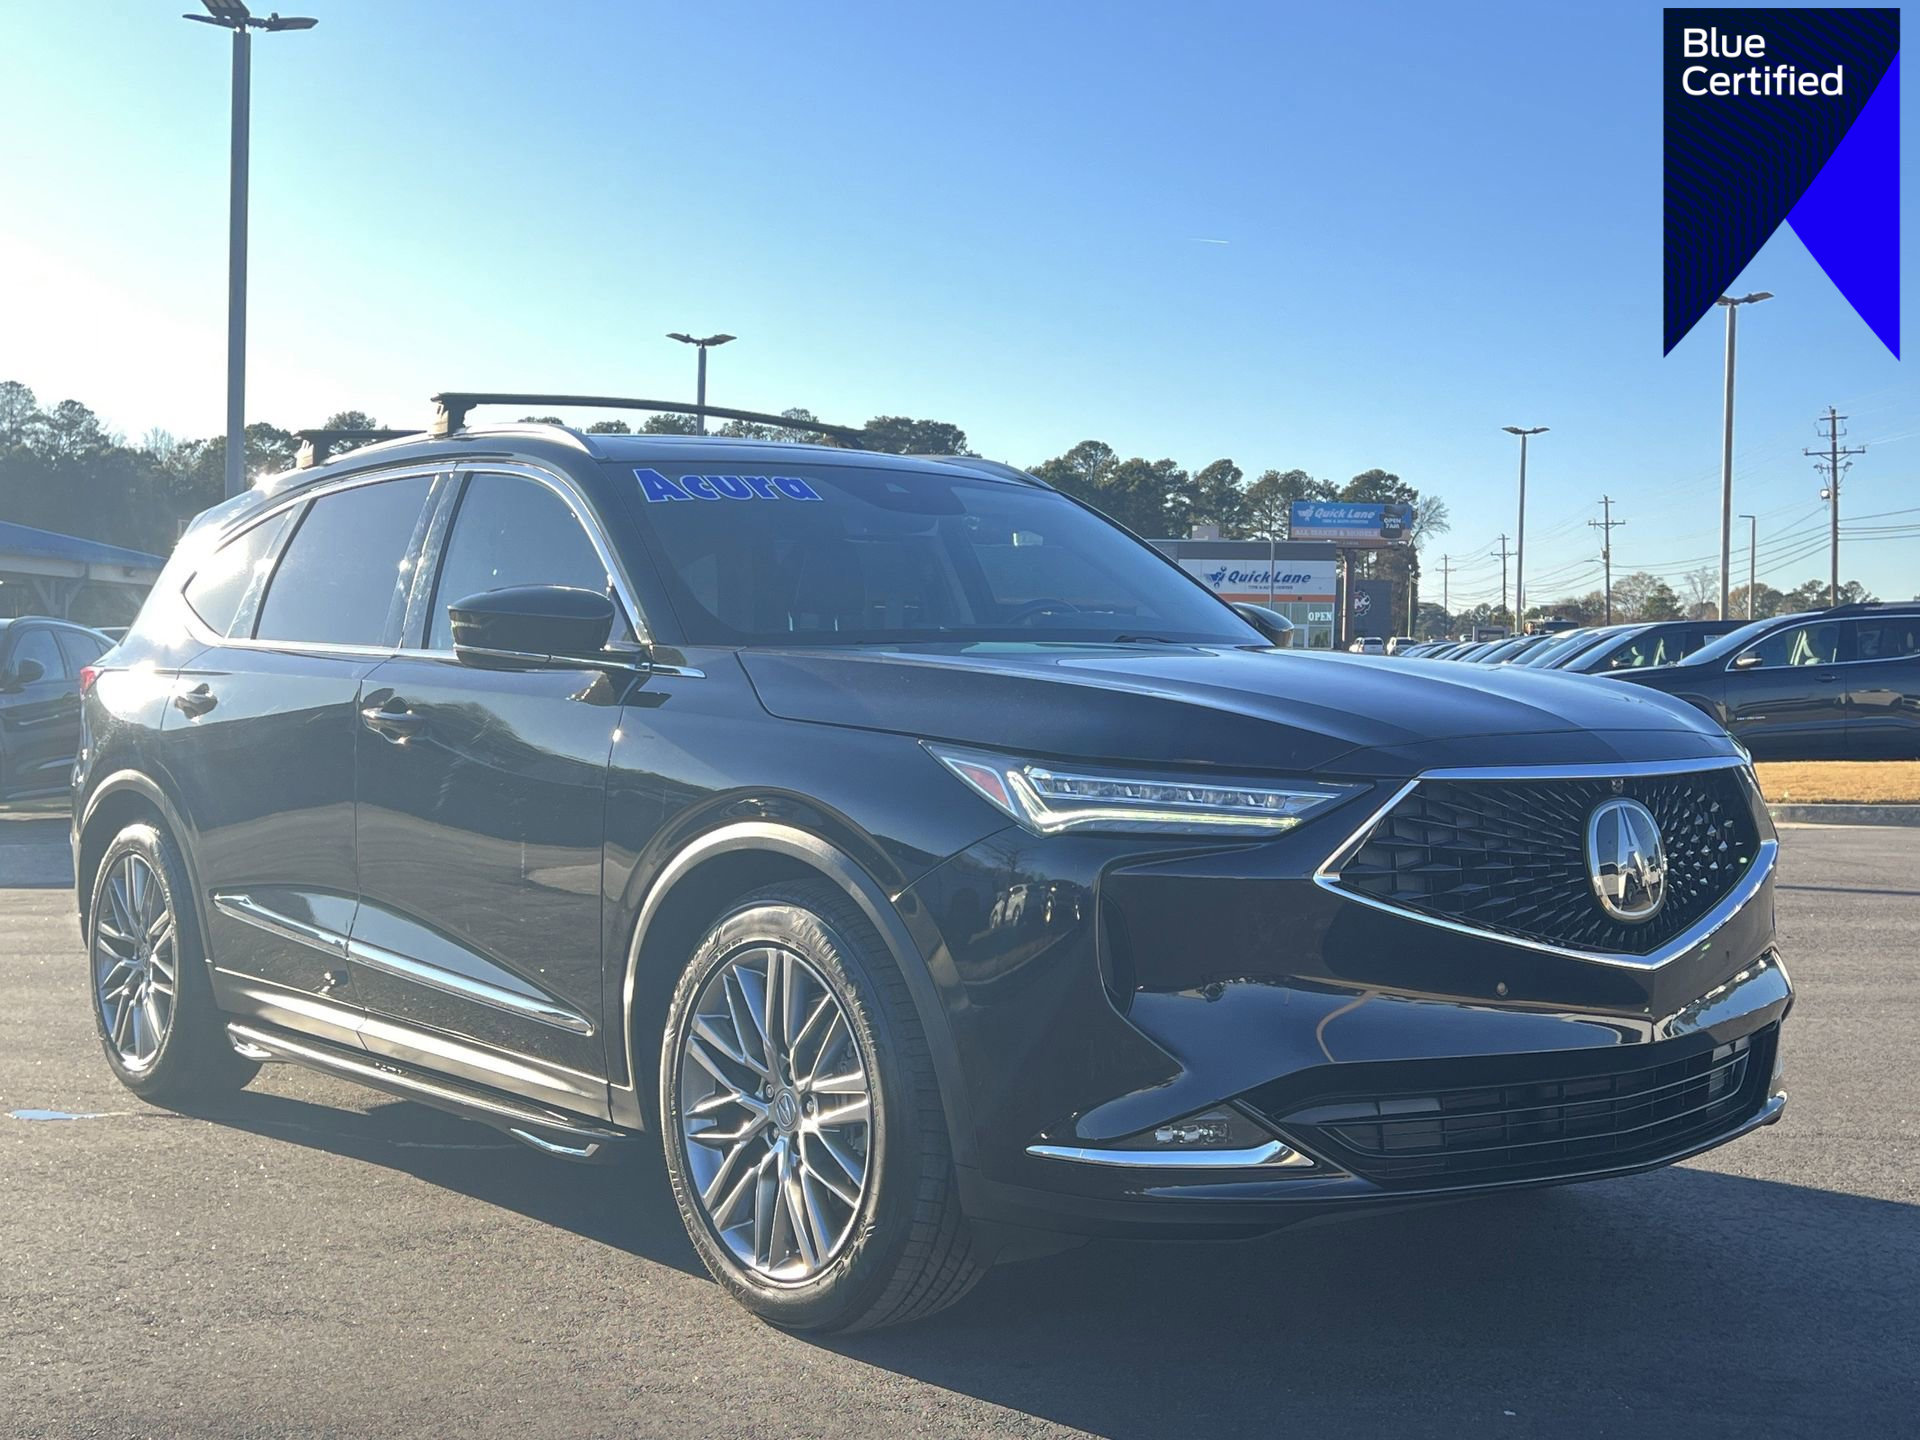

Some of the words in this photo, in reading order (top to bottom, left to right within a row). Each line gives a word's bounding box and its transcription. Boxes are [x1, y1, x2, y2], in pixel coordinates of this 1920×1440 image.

[632, 468, 823, 503] Acura
[1314, 507, 1345, 519] Quick
[1347, 508, 1376, 519] Lane
[1228, 570, 1271, 584] Quick
[1273, 571, 1312, 584] Lane
[1307, 611, 1333, 621] OPEN
